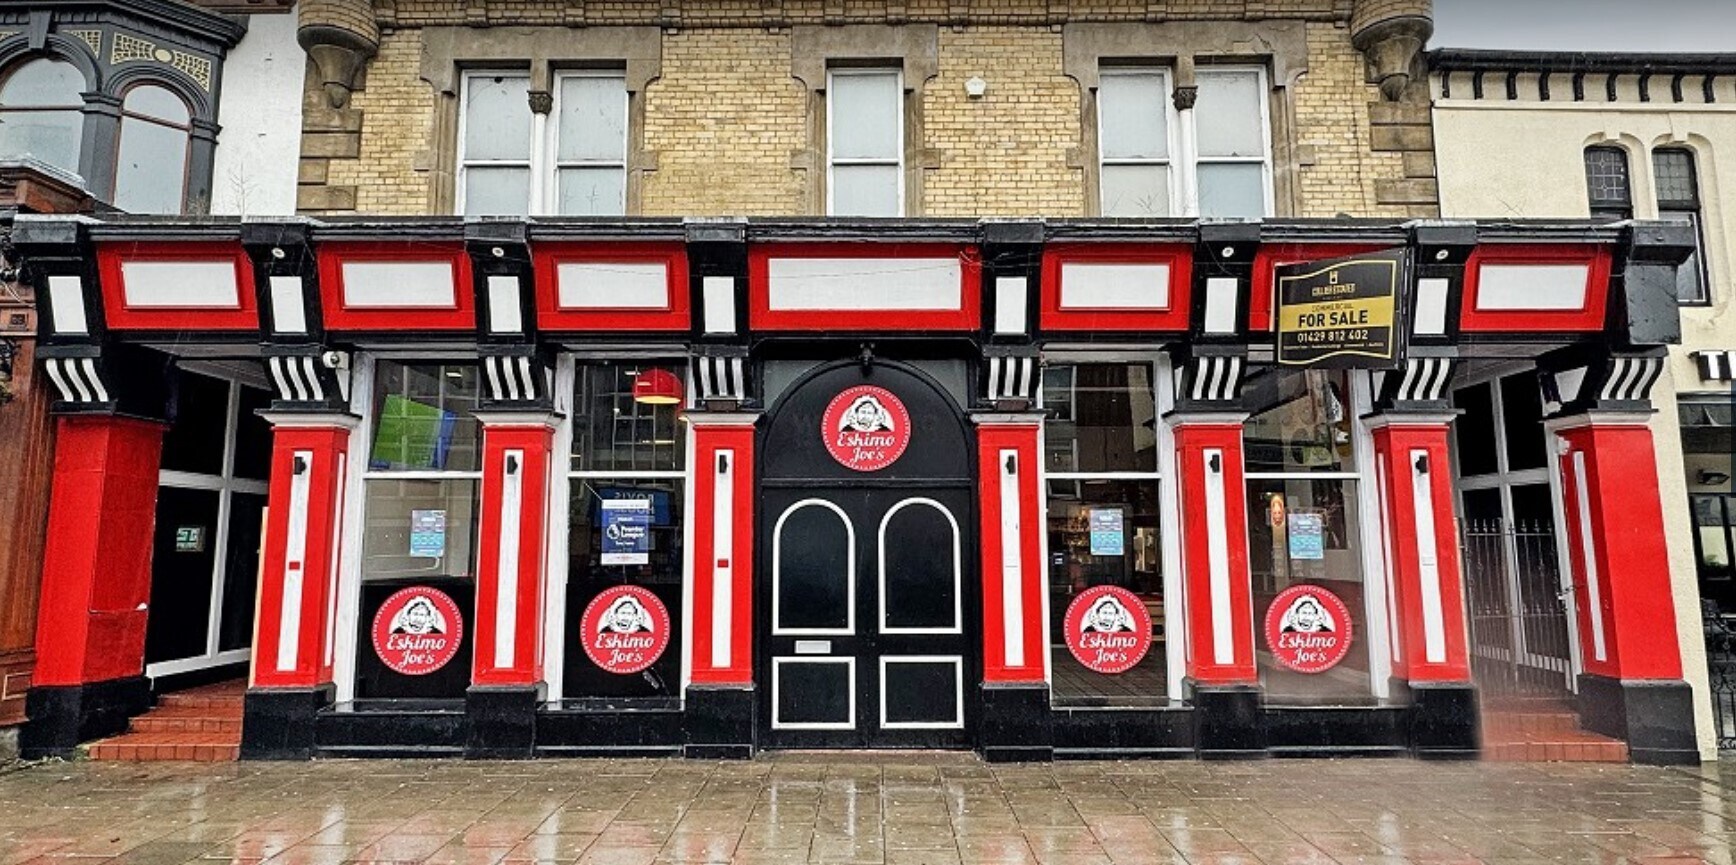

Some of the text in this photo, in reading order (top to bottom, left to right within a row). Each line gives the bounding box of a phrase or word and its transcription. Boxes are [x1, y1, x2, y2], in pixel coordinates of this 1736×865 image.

[1298, 310, 1368, 328] FOR SALE
[1297, 330, 1368, 343] 01429 812 402
[837, 431, 895, 447] Eskimo
[849, 446, 885, 462] Joe's
[387, 633, 446, 650] Eskimo
[595, 633, 654, 649] Eskimo
[1079, 633, 1137, 648] Eskimo
[1278, 633, 1336, 648] Eskimo
[398, 649, 435, 667] Joe's
[607, 648, 643, 667] Joe's
[1092, 648, 1127, 667] Joe's
[1291, 648, 1327, 665] Joe's
